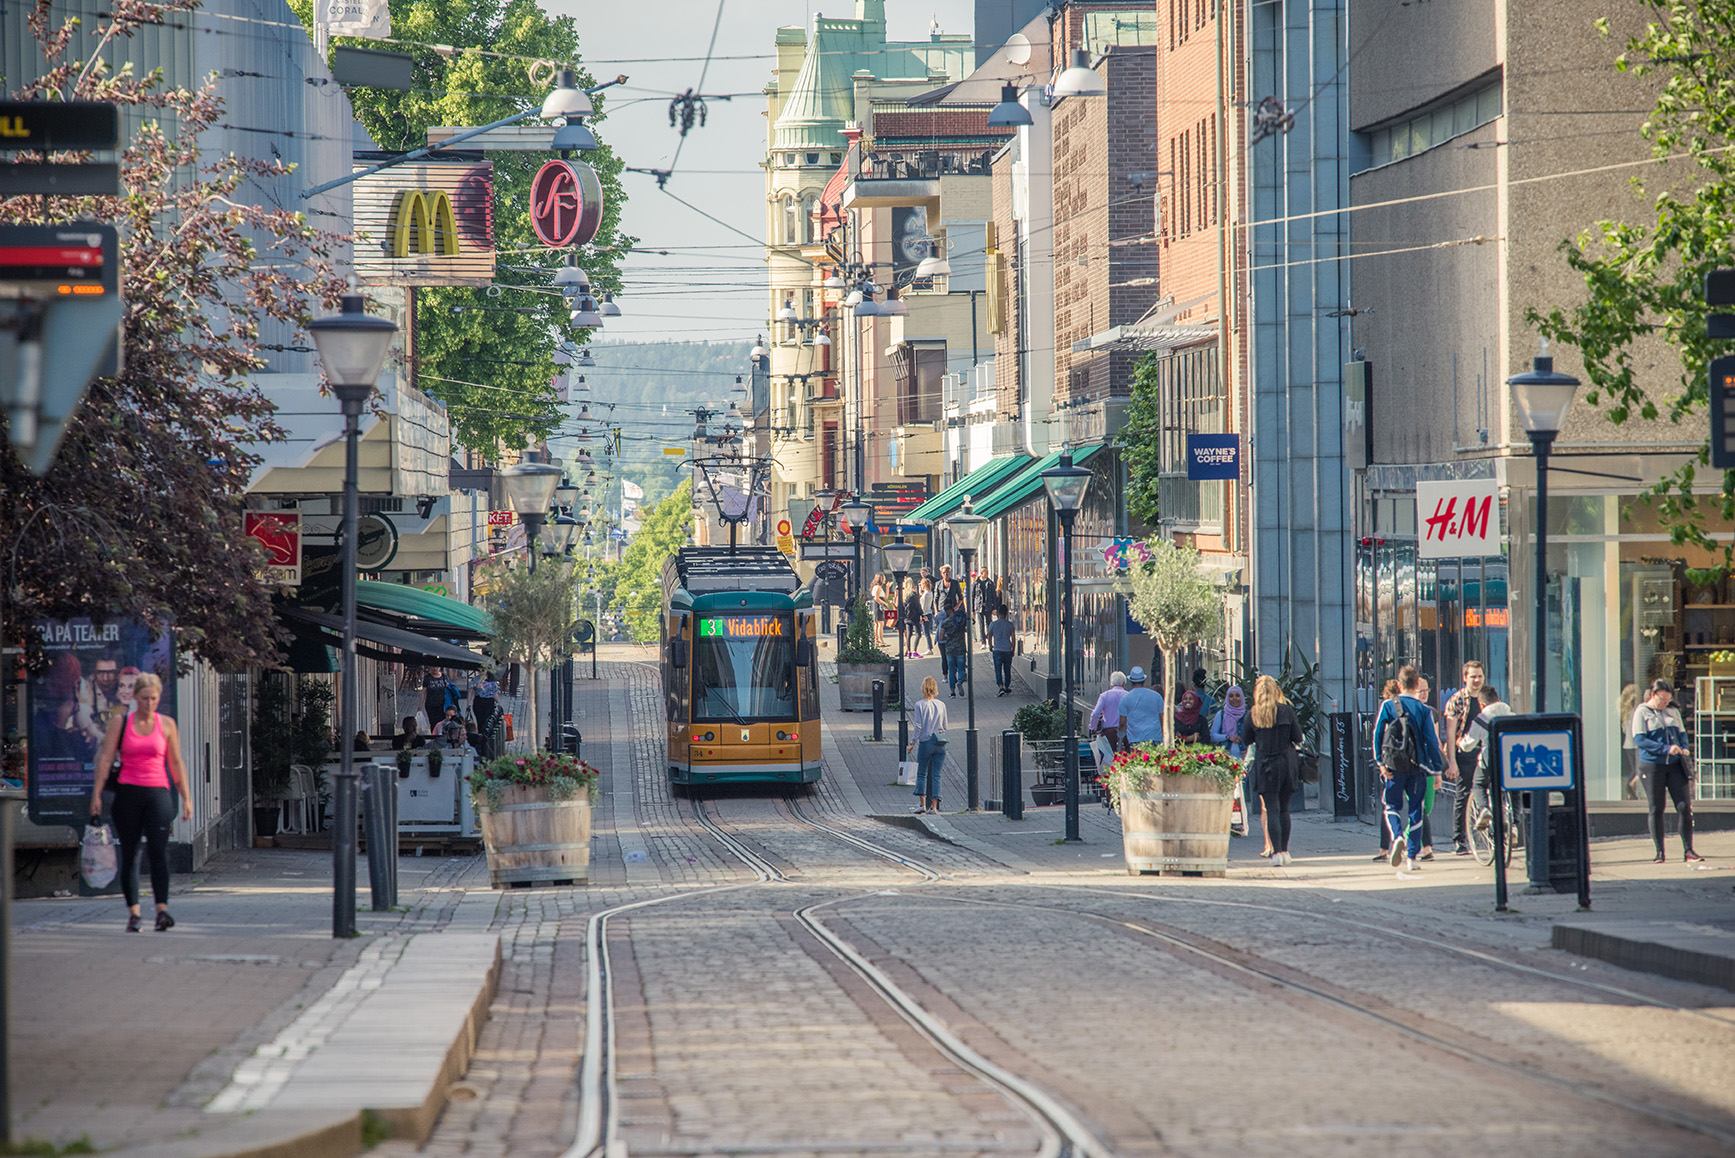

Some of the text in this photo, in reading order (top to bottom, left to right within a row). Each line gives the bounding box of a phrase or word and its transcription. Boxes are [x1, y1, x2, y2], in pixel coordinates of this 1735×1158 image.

[1193, 447, 1237, 456] WAYNE'S
[1196, 455, 1234, 463] COFFEE
[1425, 494, 1493, 542] H&M
[73, 624, 120, 642] TEAER
[706, 617, 783, 637] 3 Vidablick
